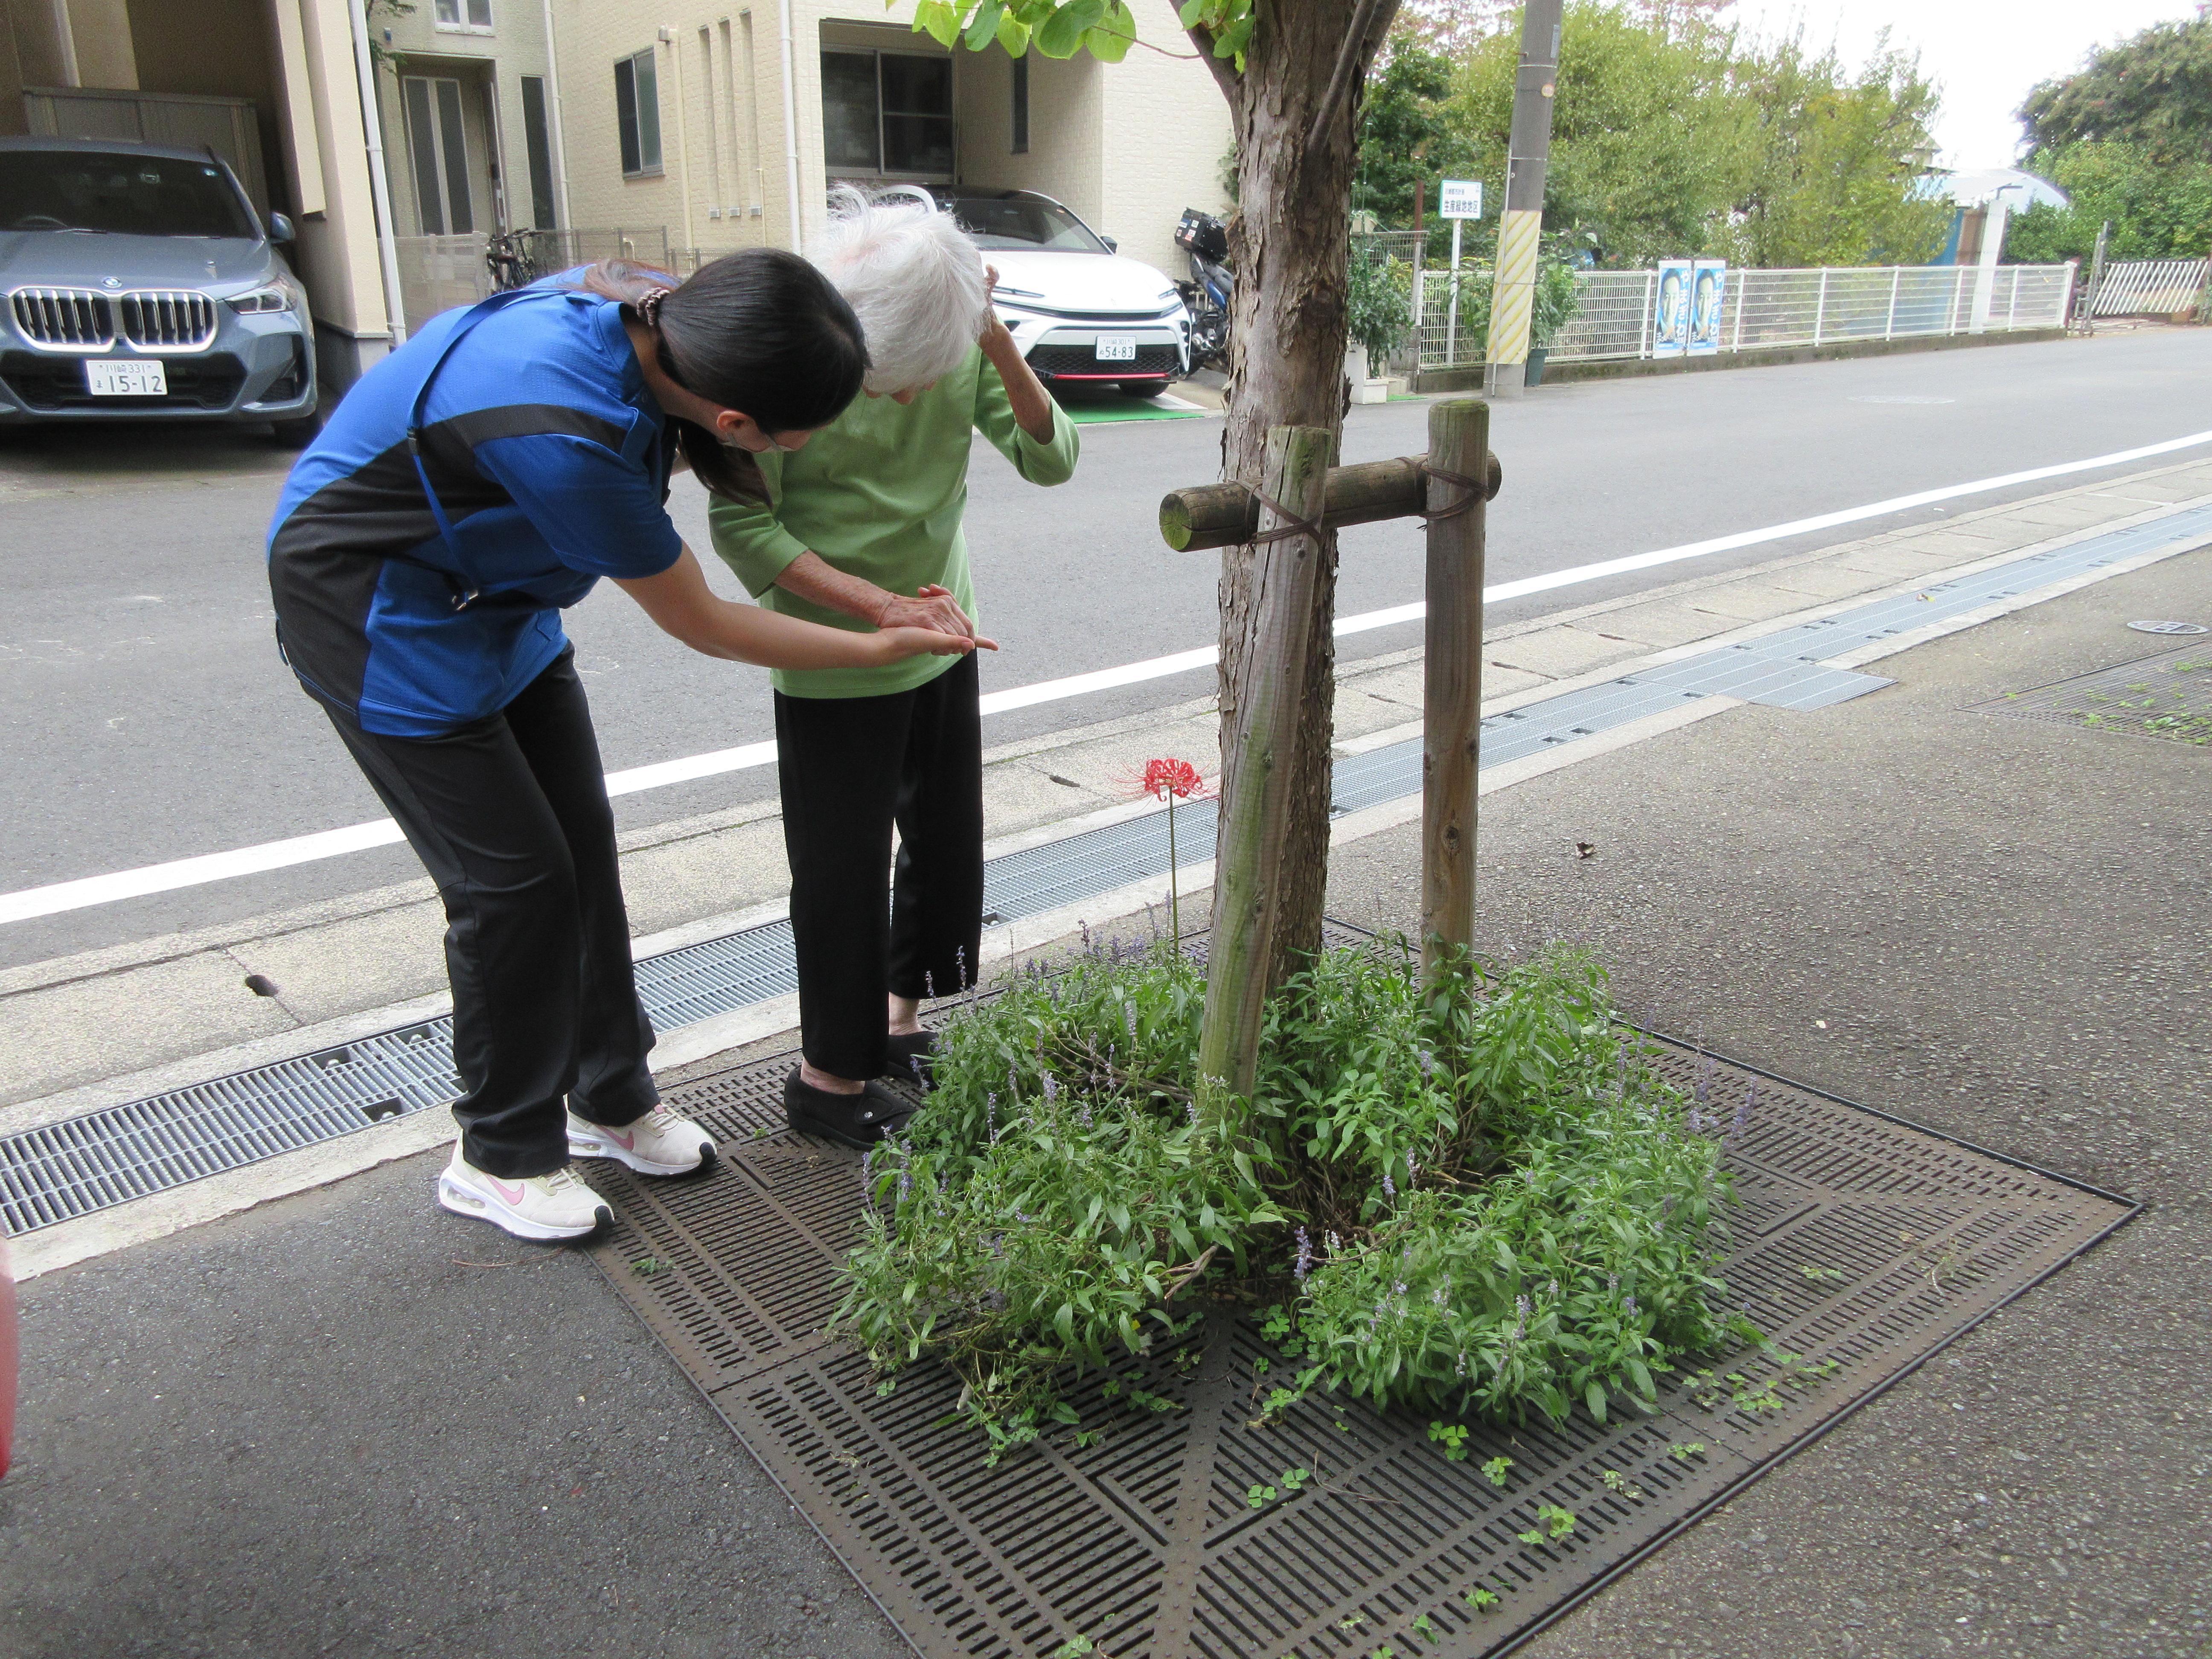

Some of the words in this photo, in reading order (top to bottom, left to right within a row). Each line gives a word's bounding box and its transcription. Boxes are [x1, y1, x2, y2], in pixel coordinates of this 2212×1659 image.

[1106, 346, 1133, 358] 54-83
[107, 364, 127, 373] 川崎
[128, 364, 146, 373] 331
[109, 375, 162, 392] 15-12
